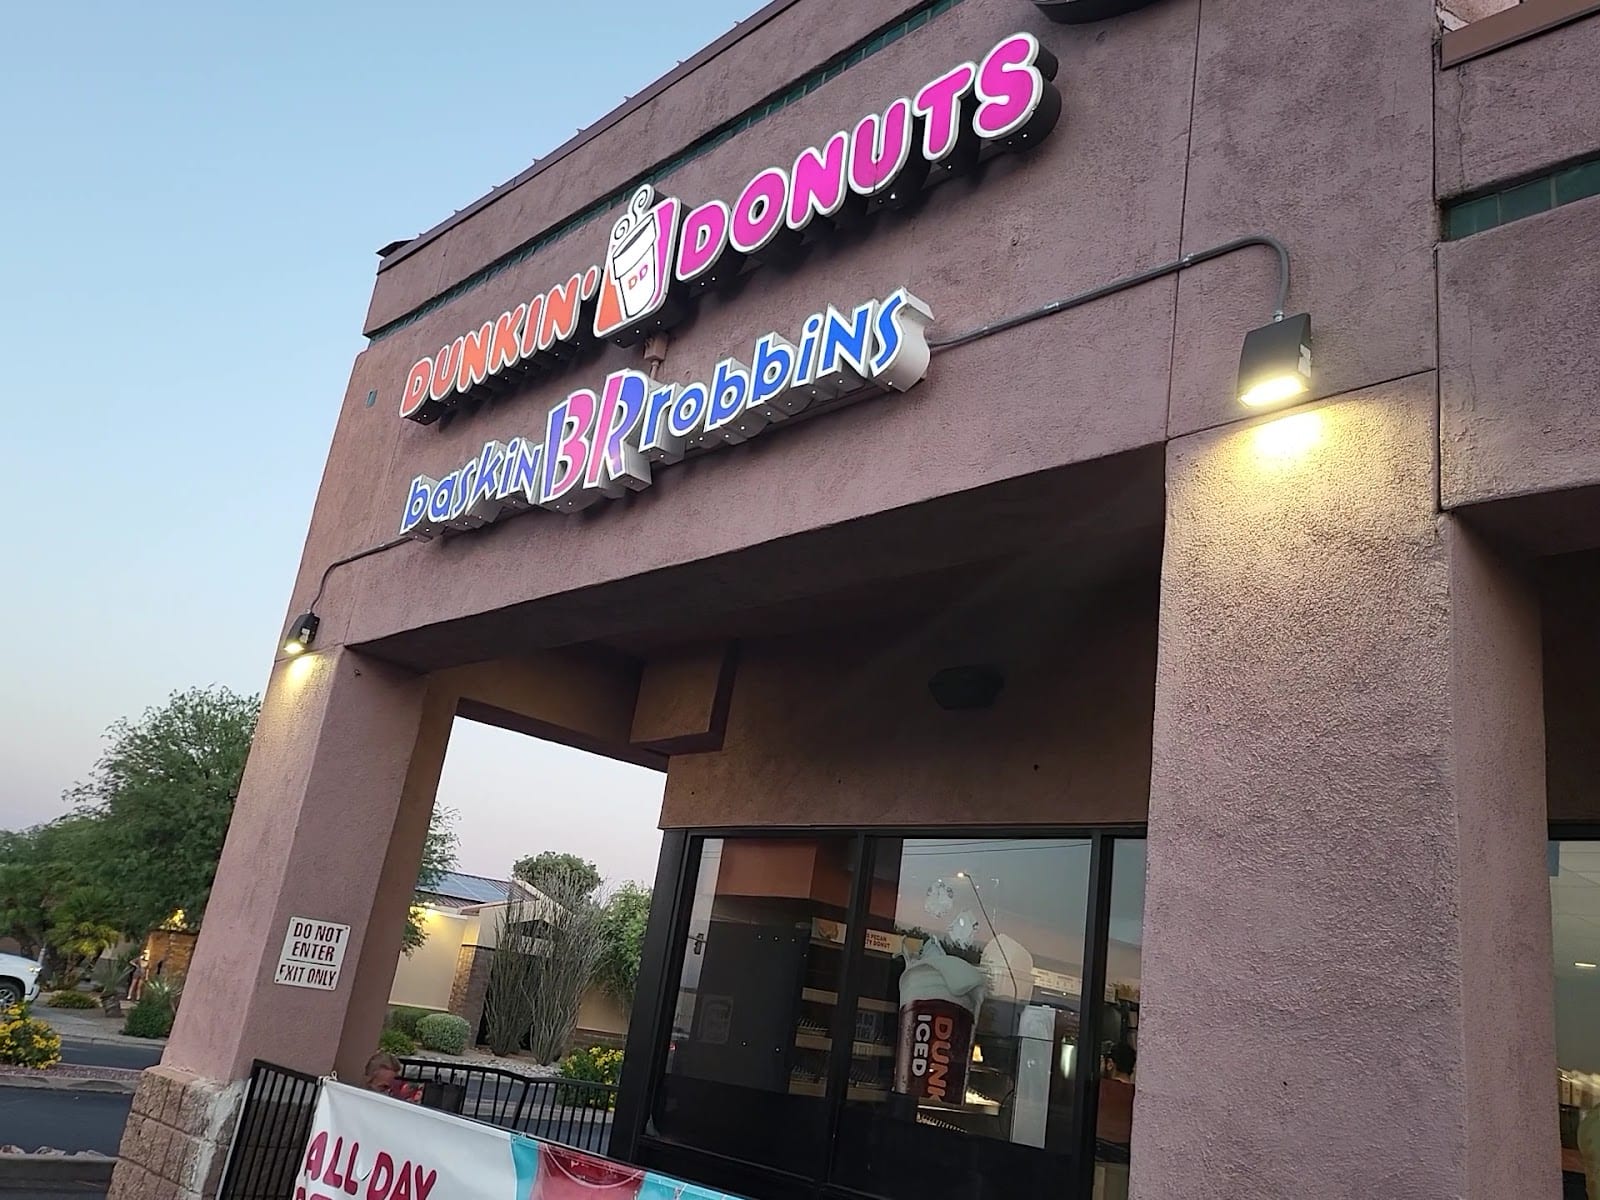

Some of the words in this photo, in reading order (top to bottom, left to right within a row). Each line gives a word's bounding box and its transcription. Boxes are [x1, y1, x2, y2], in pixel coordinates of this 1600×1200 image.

[400, 265, 601, 417] DUNKIN'
[676, 32, 1043, 281] DONUTS
[540, 370, 648, 503] BR
[291, 941, 335, 962] ENTER
[293, 922, 313, 939] DO
[314, 925, 344, 943] NOT
[873, 940, 890, 949] DONUT
[307, 968, 337, 986] ONLY
[912, 1014, 932, 1077] ICED
[305, 1131, 359, 1196] ALL
[367, 1151, 437, 1200] DAY
